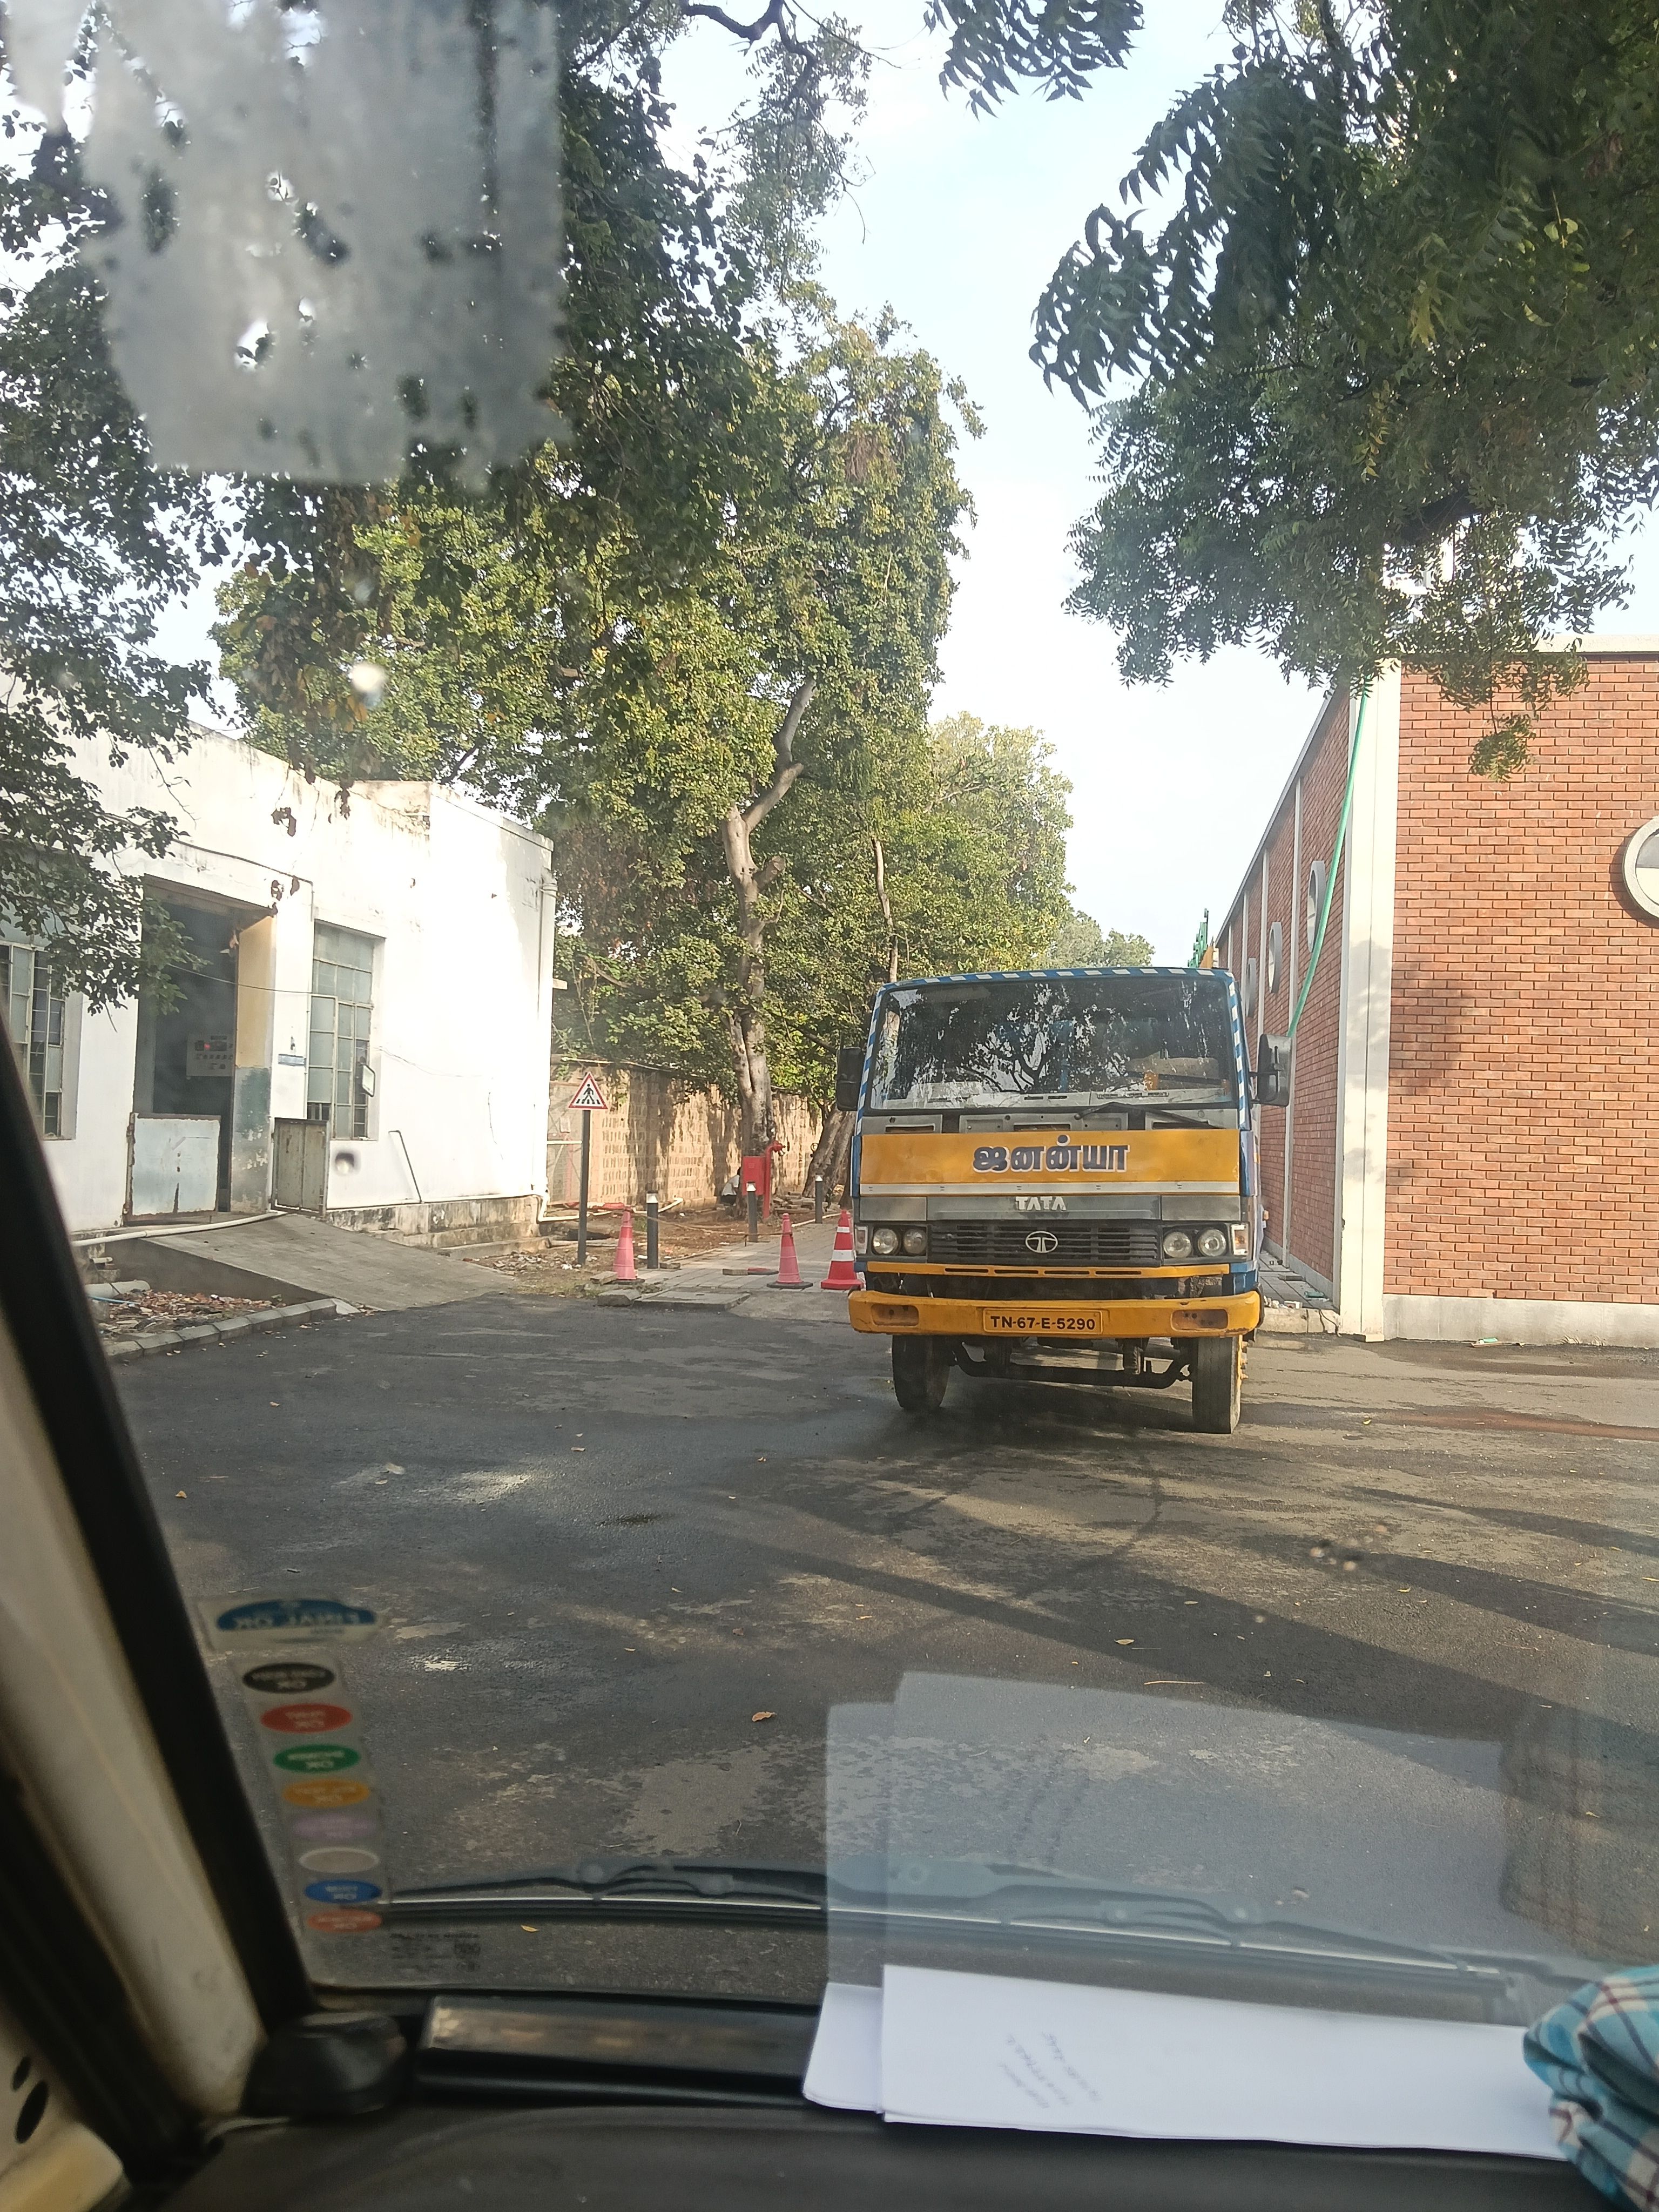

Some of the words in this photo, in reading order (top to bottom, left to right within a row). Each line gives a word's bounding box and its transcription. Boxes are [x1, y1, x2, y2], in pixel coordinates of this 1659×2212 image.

[973, 1134, 1130, 1173] ஜனன்யா
[1015, 1196, 1067, 1211] TATA
[990, 1316, 1095, 1330] TN-67-E-5290
